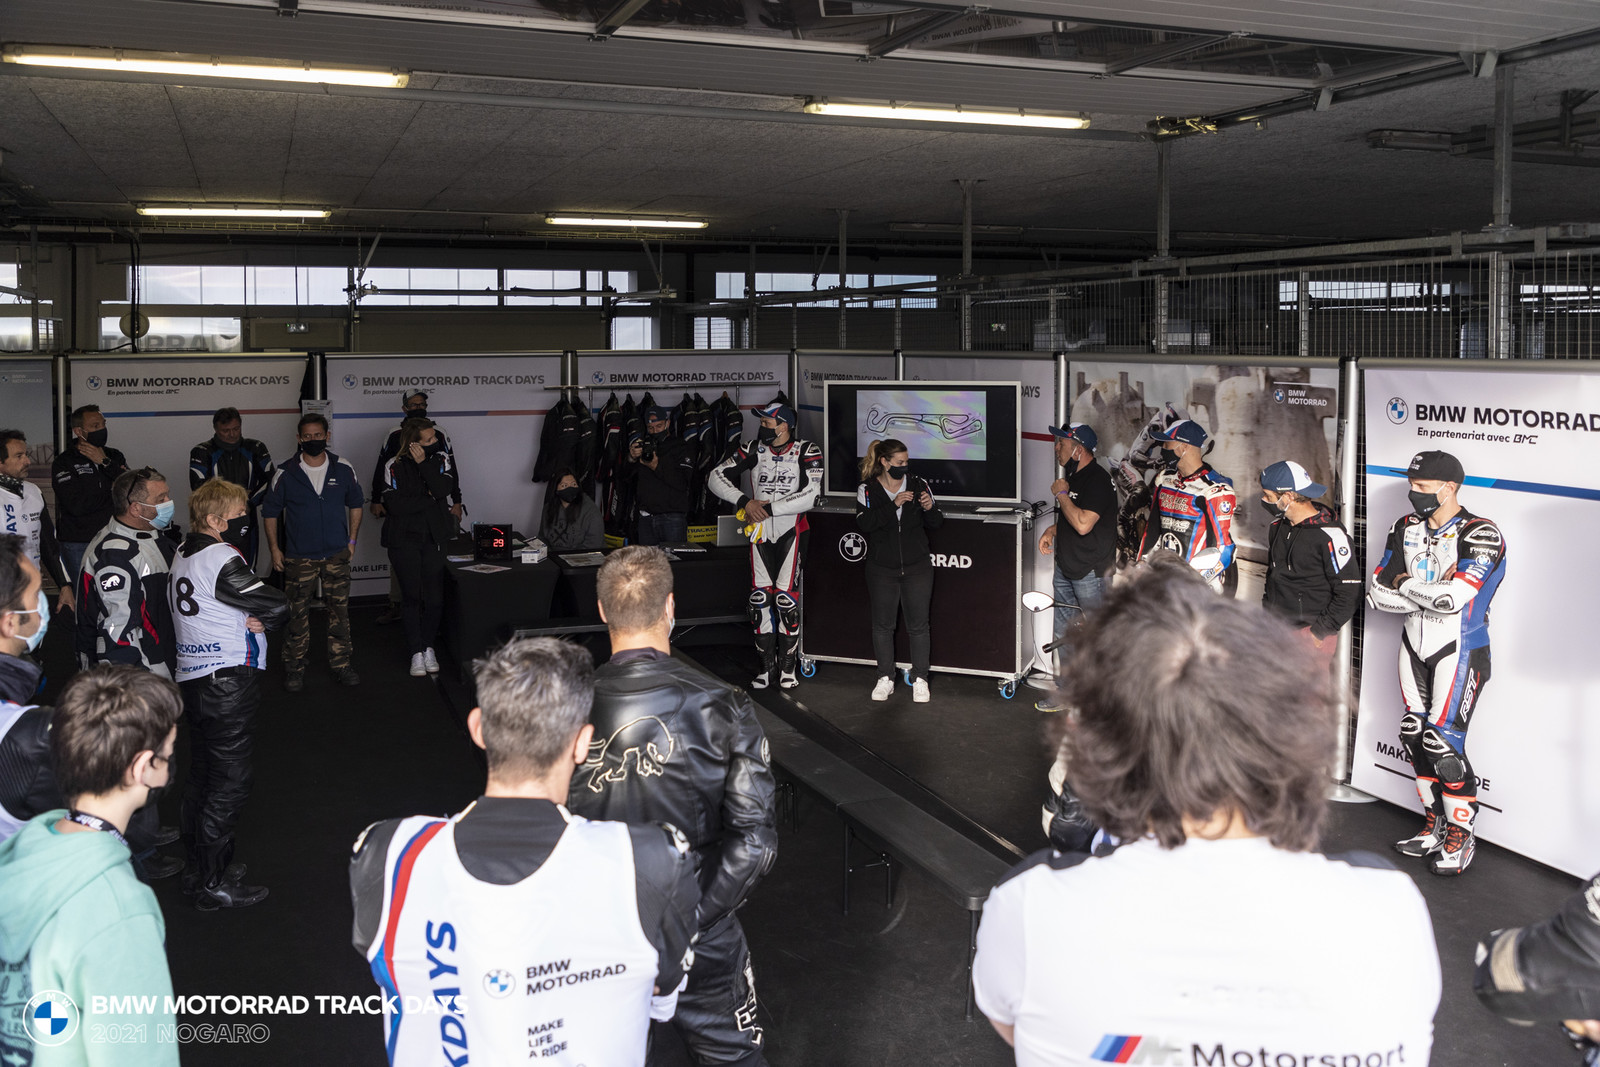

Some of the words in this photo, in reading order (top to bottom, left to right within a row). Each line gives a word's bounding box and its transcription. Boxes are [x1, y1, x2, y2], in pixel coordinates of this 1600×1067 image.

[106, 378, 139, 388] BMW
[143, 377, 214, 387] MOTORRAD
[218, 376, 257, 386] TRACK
[260, 375, 290, 385] DAYS
[362, 377, 395, 387] BMW
[398, 376, 470, 386] MOTORRAD
[473, 375, 513, 385] TRACK
[515, 375, 545, 385] DAYS
[610, 373, 639, 383] BMW
[642, 373, 706, 383] MOTORRAD
[710, 372, 745, 382] TRACK
[747, 372, 774, 381] DAYS
[1288, 389, 1306, 397] BMW
[1288, 398, 1328, 406] MOTORRAD
[1415, 404, 1466, 423] BMW
[1473, 407, 1600, 432] MOTORRAD
[1417, 427, 1429, 436] En
[1430, 430, 1485, 441] partenariat
[1487, 434, 1510, 443] avec
[492, 538, 505, 548] 29
[350, 565, 369, 573] AKE
[370, 564, 388, 572] LIFE
[929, 553, 973, 569] RRAD
[1474, 775, 1490, 791] DE
[526, 958, 571, 979] BMW
[526, 963, 627, 996] MOTORRAD
[527, 1018, 564, 1036] MAKE
[529, 1033, 553, 1048] LIFE
[529, 1050, 537, 1059] A
[541, 1041, 567, 1058] RIDE
